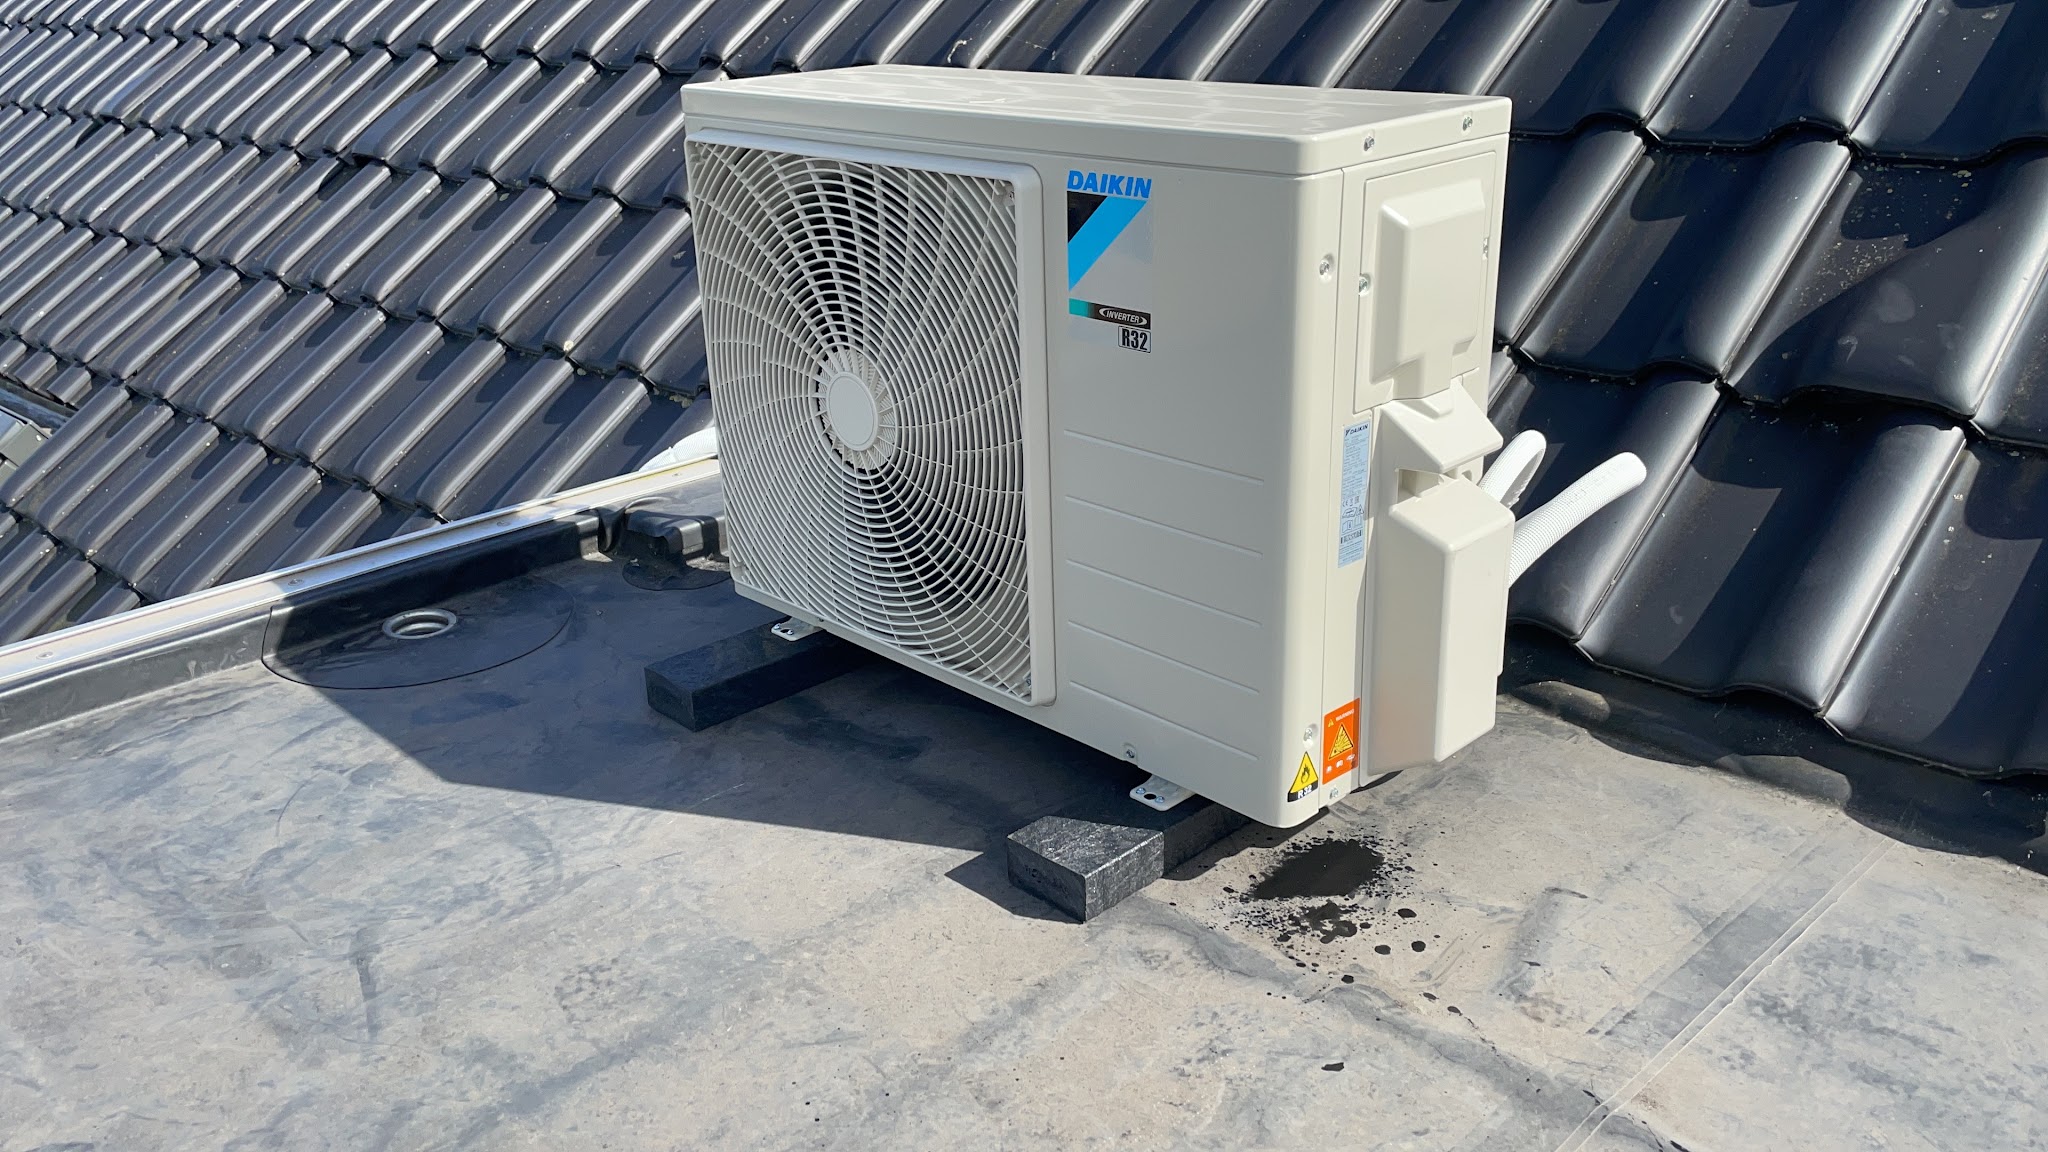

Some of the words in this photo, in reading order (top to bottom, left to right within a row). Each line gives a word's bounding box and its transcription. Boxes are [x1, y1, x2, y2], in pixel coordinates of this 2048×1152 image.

[1067, 170, 1152, 199] DAIKIN
[1106, 310, 1140, 323] INVERTER
[1122, 328, 1148, 351] R32
[1350, 423, 1368, 434] DAIKIN
